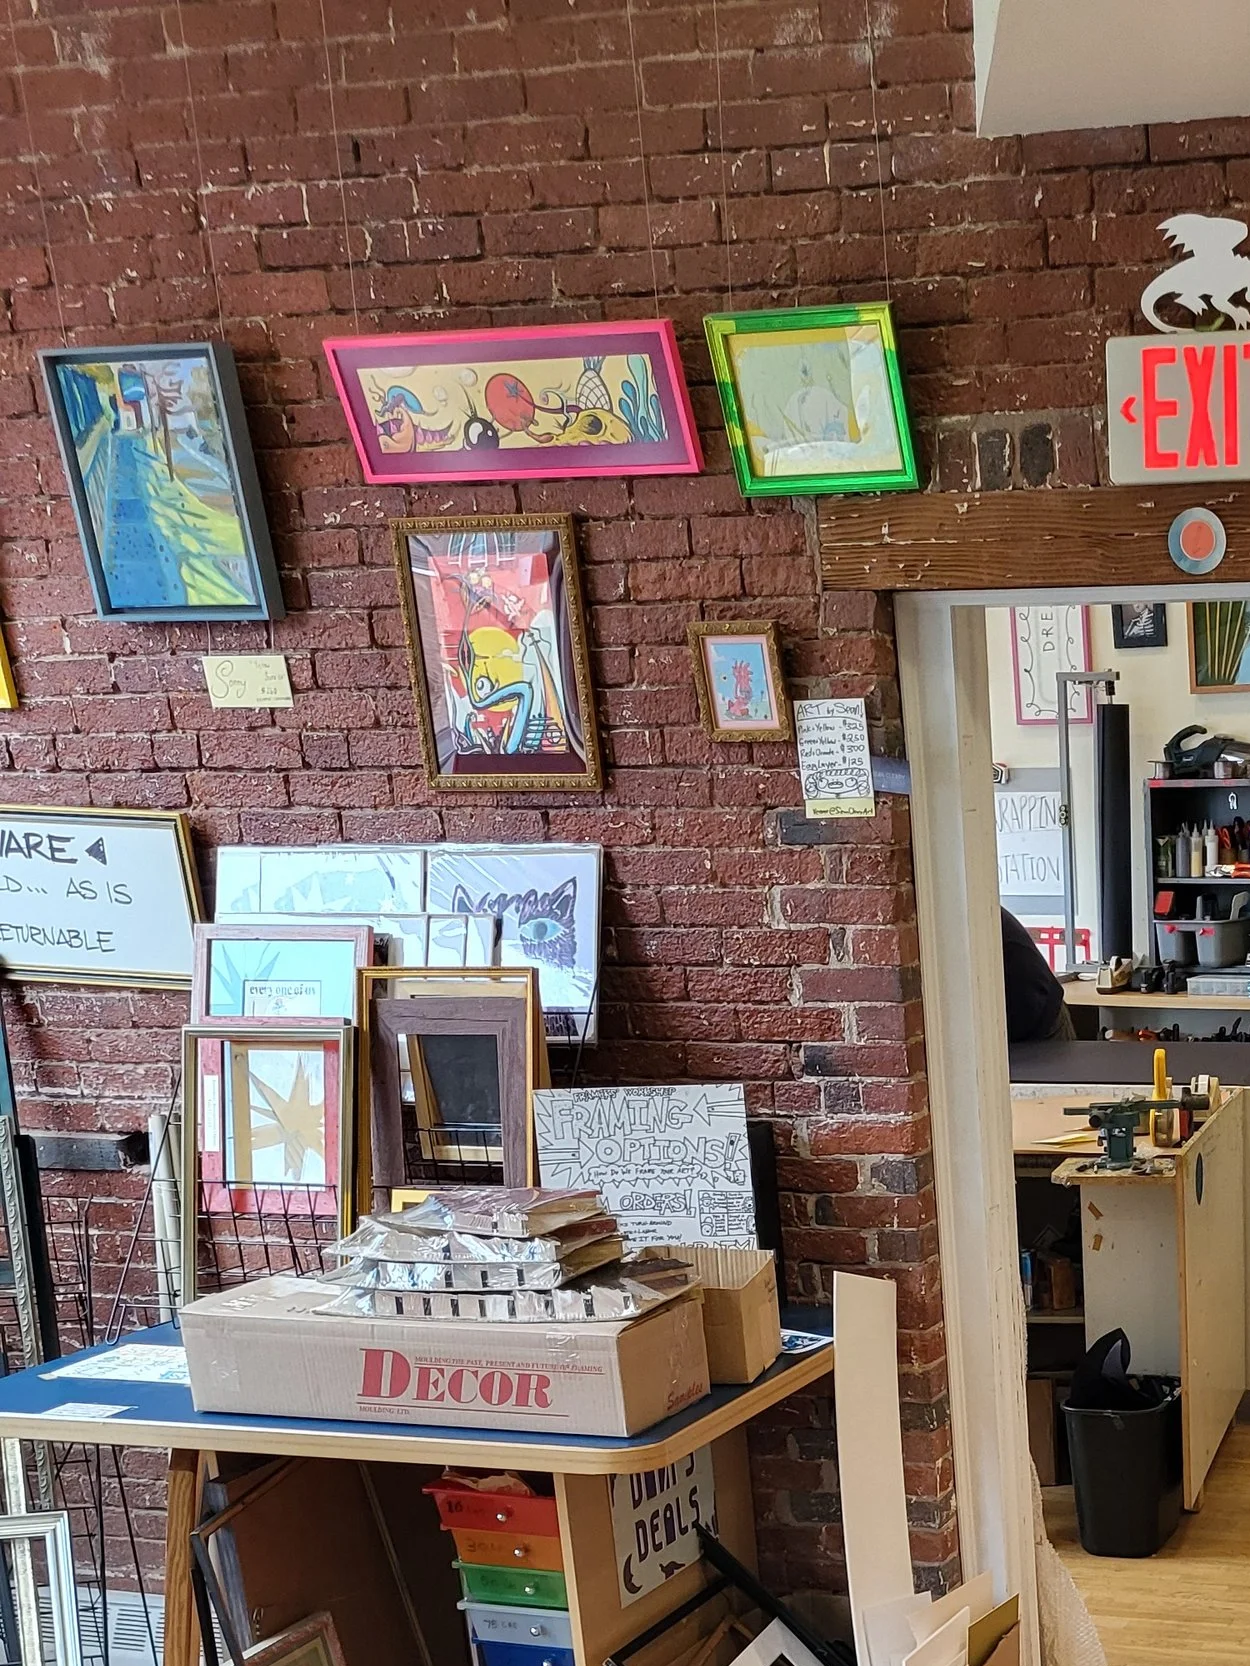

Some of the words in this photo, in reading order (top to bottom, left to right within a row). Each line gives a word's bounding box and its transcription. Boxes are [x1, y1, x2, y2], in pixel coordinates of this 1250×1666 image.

[797, 701, 829, 717] ART
[842, 720, 864, 732] $325
[840, 743, 865, 754] $300
[842, 733, 865, 743] $250
[842, 755, 864, 767] $125
[995, 795, 1063, 831] RAPPIN
[66, 877, 98, 900] AS
[106, 881, 133, 905] IS
[0, 923, 116, 953] ETURNABLE
[623, 1087, 677, 1098] WORKSHOP
[551, 1096, 693, 1141] FRAMING
[595, 1133, 742, 1171] OPTIONS!
[619, 1189, 693, 1216] ORDERS!
[415, 1356, 451, 1364] MOULDING
[451, 1357, 465, 1365] THE
[466, 1358, 484, 1367] PAST,
[485, 1359, 515, 1368] PRESENT
[356, 1348, 554, 1409] DECOR
[359, 1405, 394, 1415] MOULDING
[634, 1485, 700, 1563] DEALS
